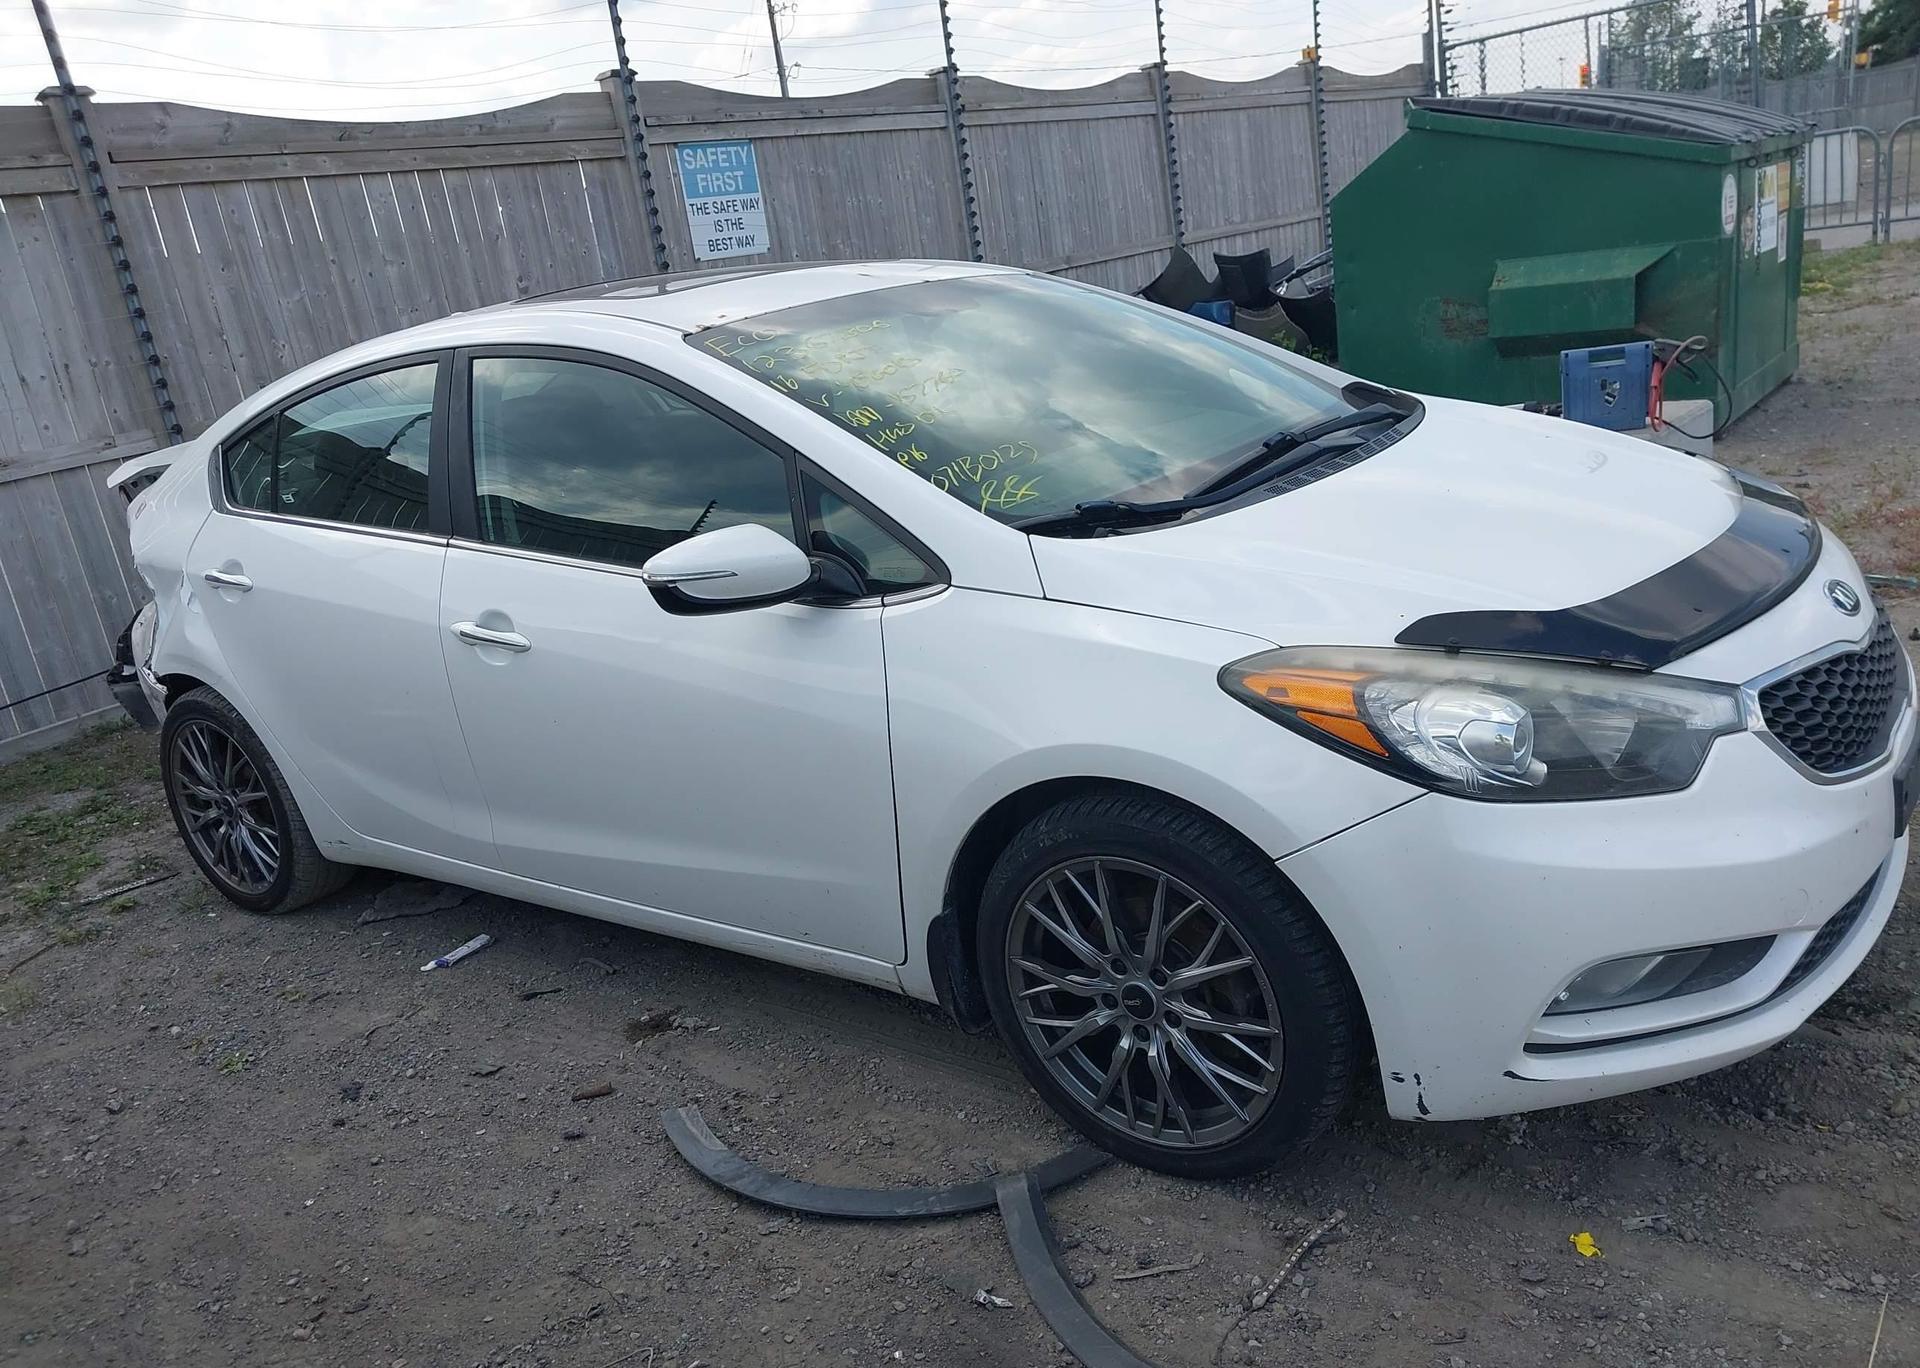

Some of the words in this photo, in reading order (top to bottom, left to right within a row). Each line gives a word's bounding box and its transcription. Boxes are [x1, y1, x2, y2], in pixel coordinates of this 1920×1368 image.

[683, 146, 748, 169] SAFETY
[697, 171, 744, 194] FIRST
[689, 202, 711, 216] THE
[712, 200, 739, 214] SAFE
[740, 197, 760, 211] WAY
[713, 219, 724, 232] IS
[725, 217, 745, 231] THE
[708, 237, 733, 252] BEST
[735, 234, 756, 248] WAY
